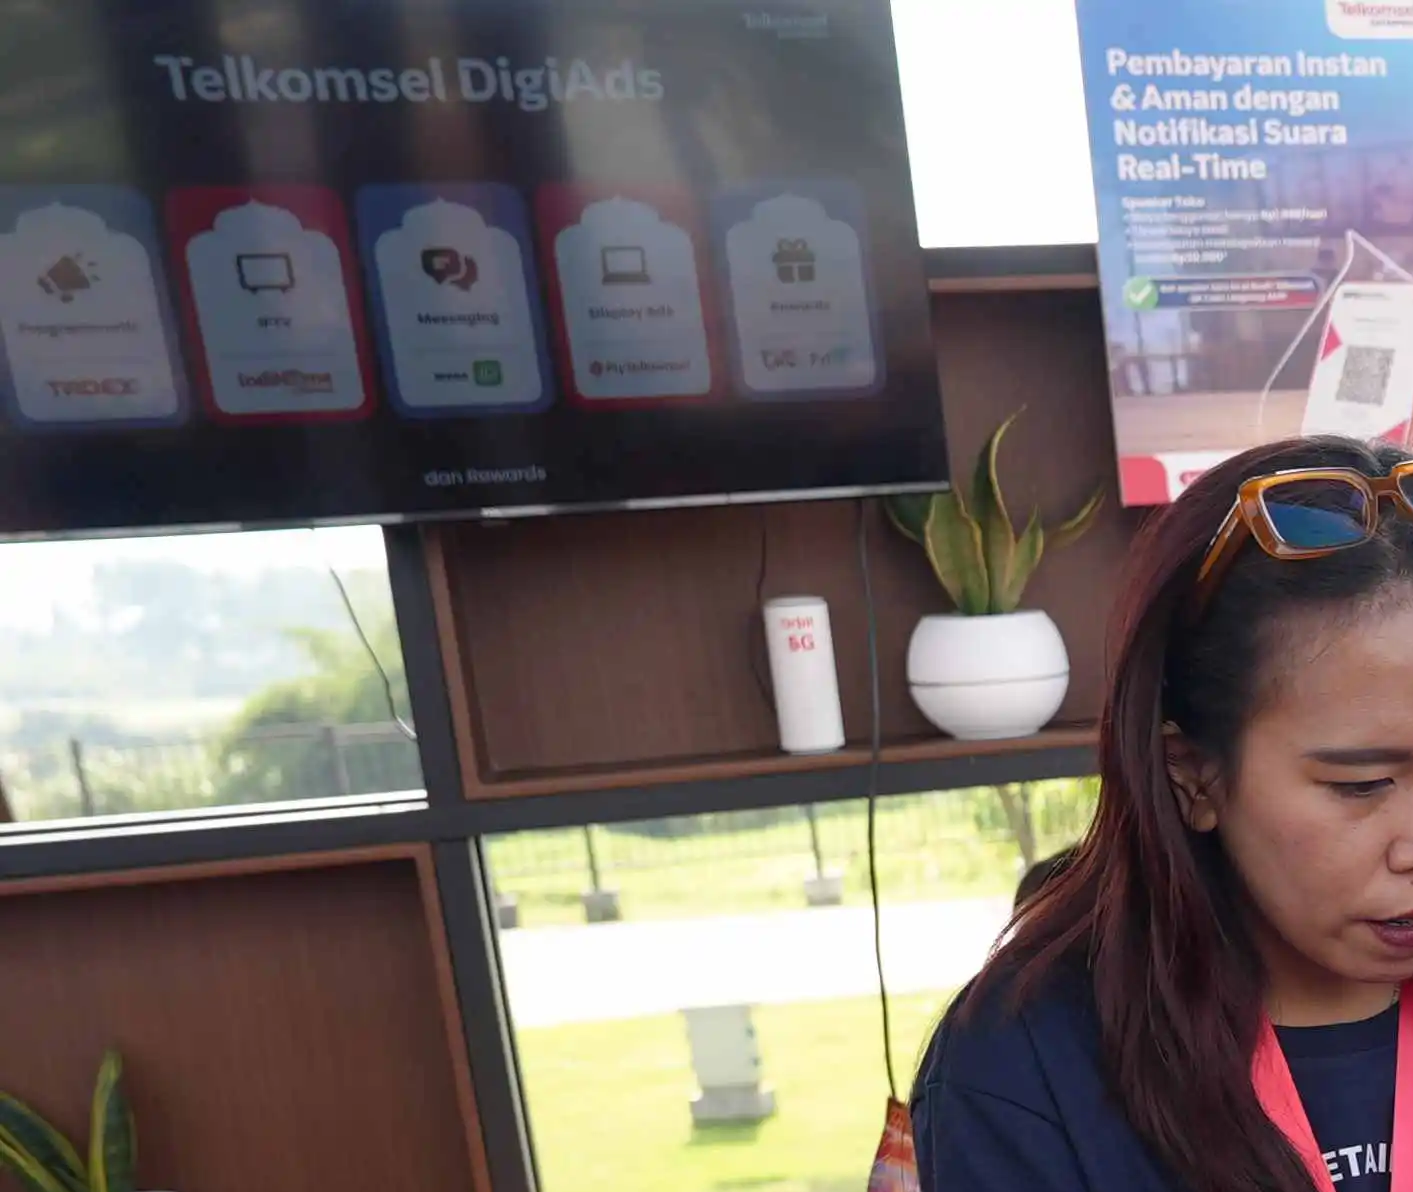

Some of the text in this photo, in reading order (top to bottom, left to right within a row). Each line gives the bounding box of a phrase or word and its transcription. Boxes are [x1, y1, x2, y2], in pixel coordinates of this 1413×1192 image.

[1106, 48, 1388, 81] Pembayaran Instan
[154, 53, 665, 111] Telkomsel DigiAds
[1110, 84, 1340, 116] & Aman dengan
[1114, 119, 1348, 146] Notifikasi Suara
[1117, 153, 1267, 181] Real-Time
[425, 464, 547, 487] dan Rewards
